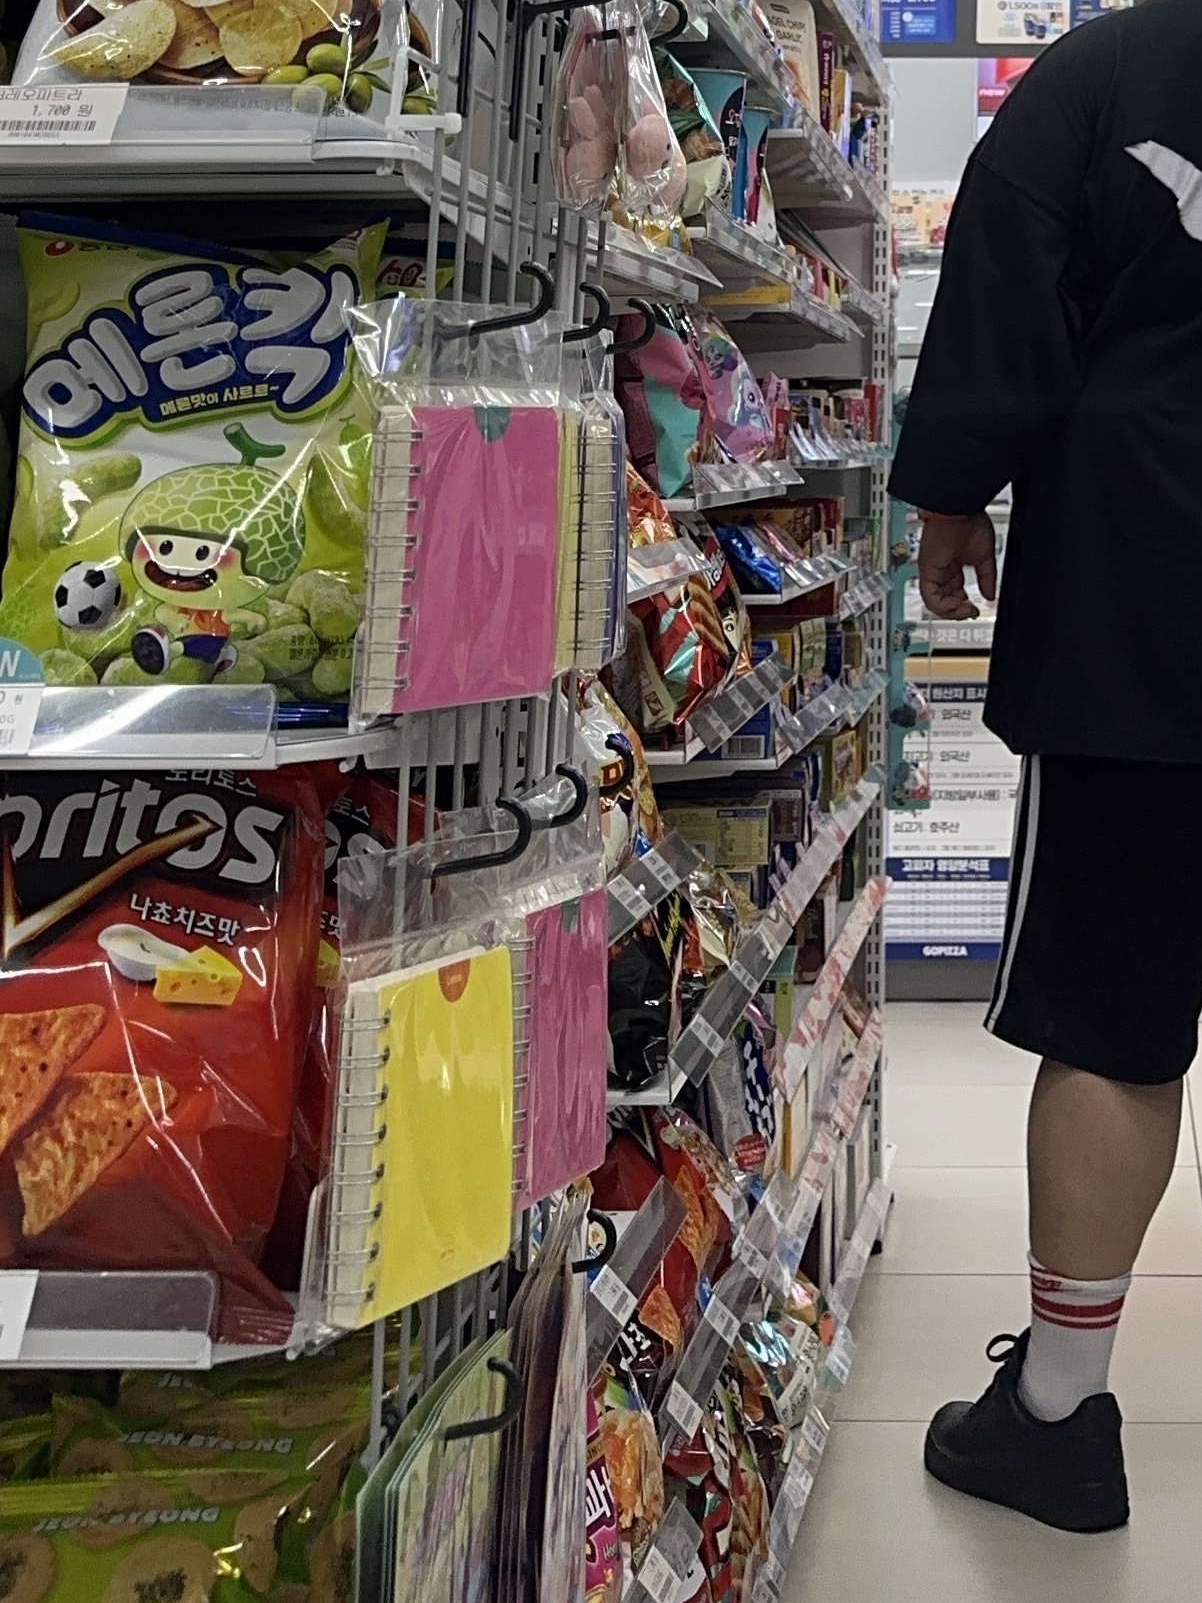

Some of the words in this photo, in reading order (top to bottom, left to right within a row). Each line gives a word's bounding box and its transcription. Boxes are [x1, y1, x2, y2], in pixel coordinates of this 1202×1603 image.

[78, 104, 93, 117] 원
[23, 269, 355, 428] 메론킥
[159, 392, 220, 417] 메론맛이
[131, 892, 241, 946] 나쵸치즈맛
